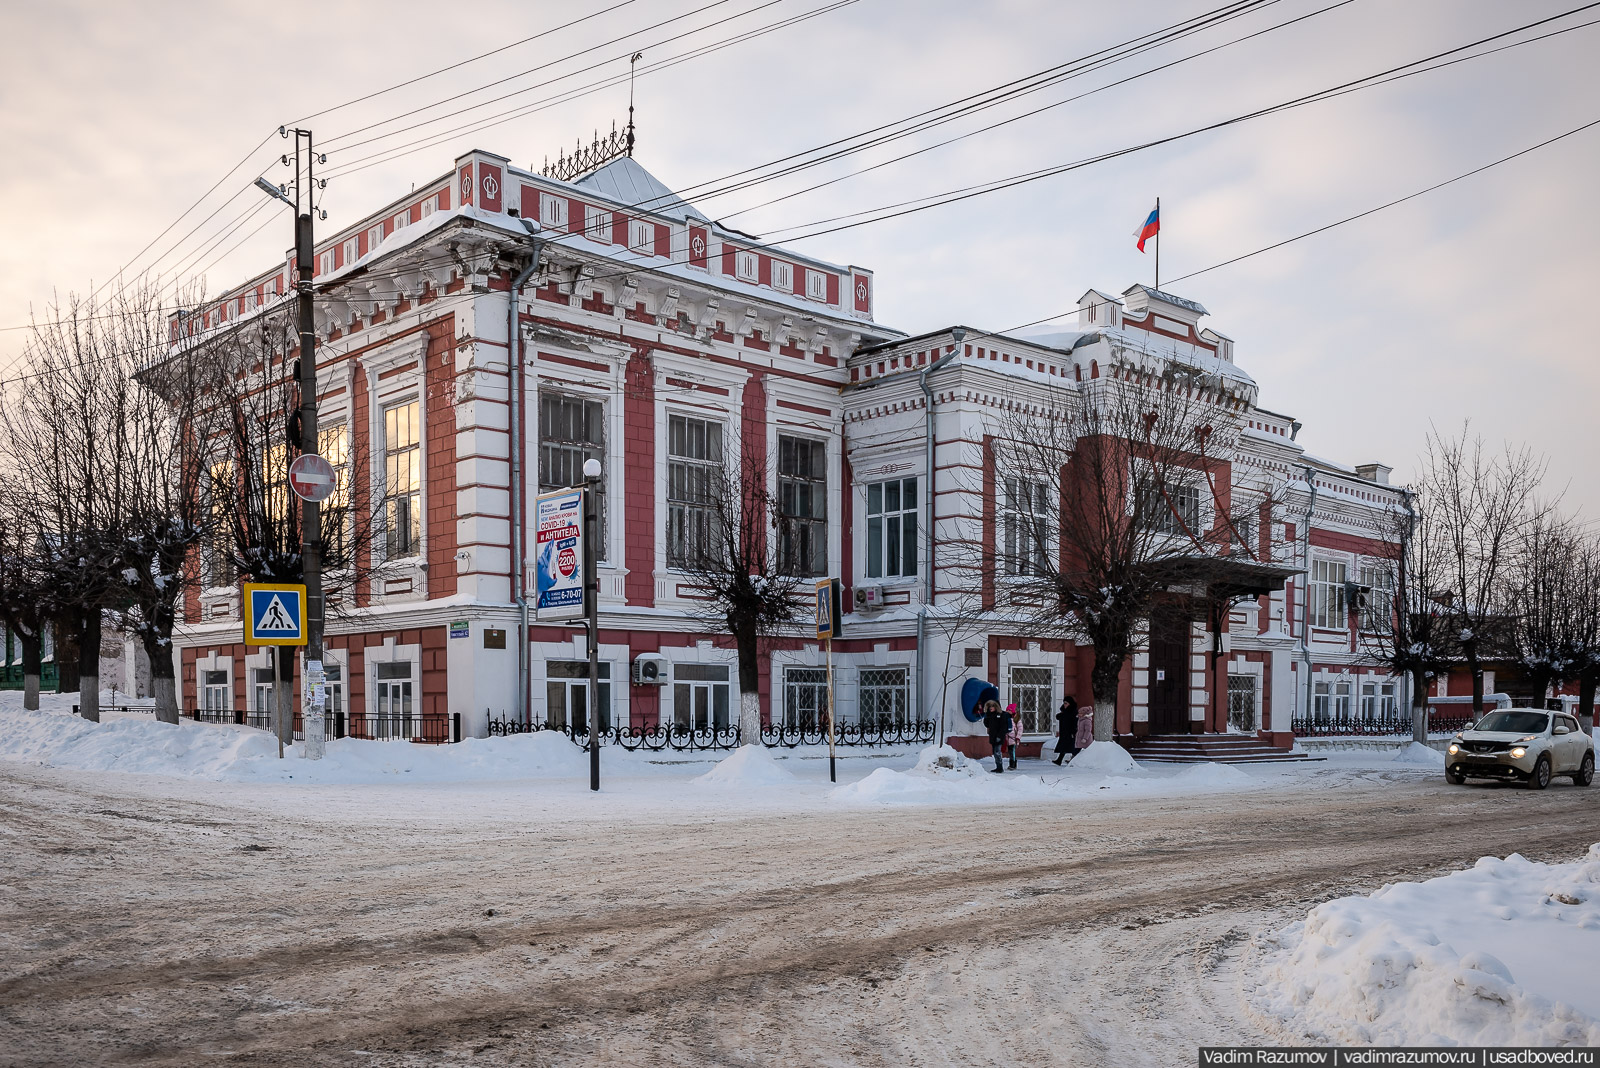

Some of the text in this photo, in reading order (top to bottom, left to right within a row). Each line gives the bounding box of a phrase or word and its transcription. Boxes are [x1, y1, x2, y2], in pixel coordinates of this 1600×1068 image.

[541, 519, 565, 530] COVID-19
[546, 527, 577, 540] АНТИТЕЛА
[559, 555, 574, 566] 2200
[561, 589, 581, 599] 6-70-07
